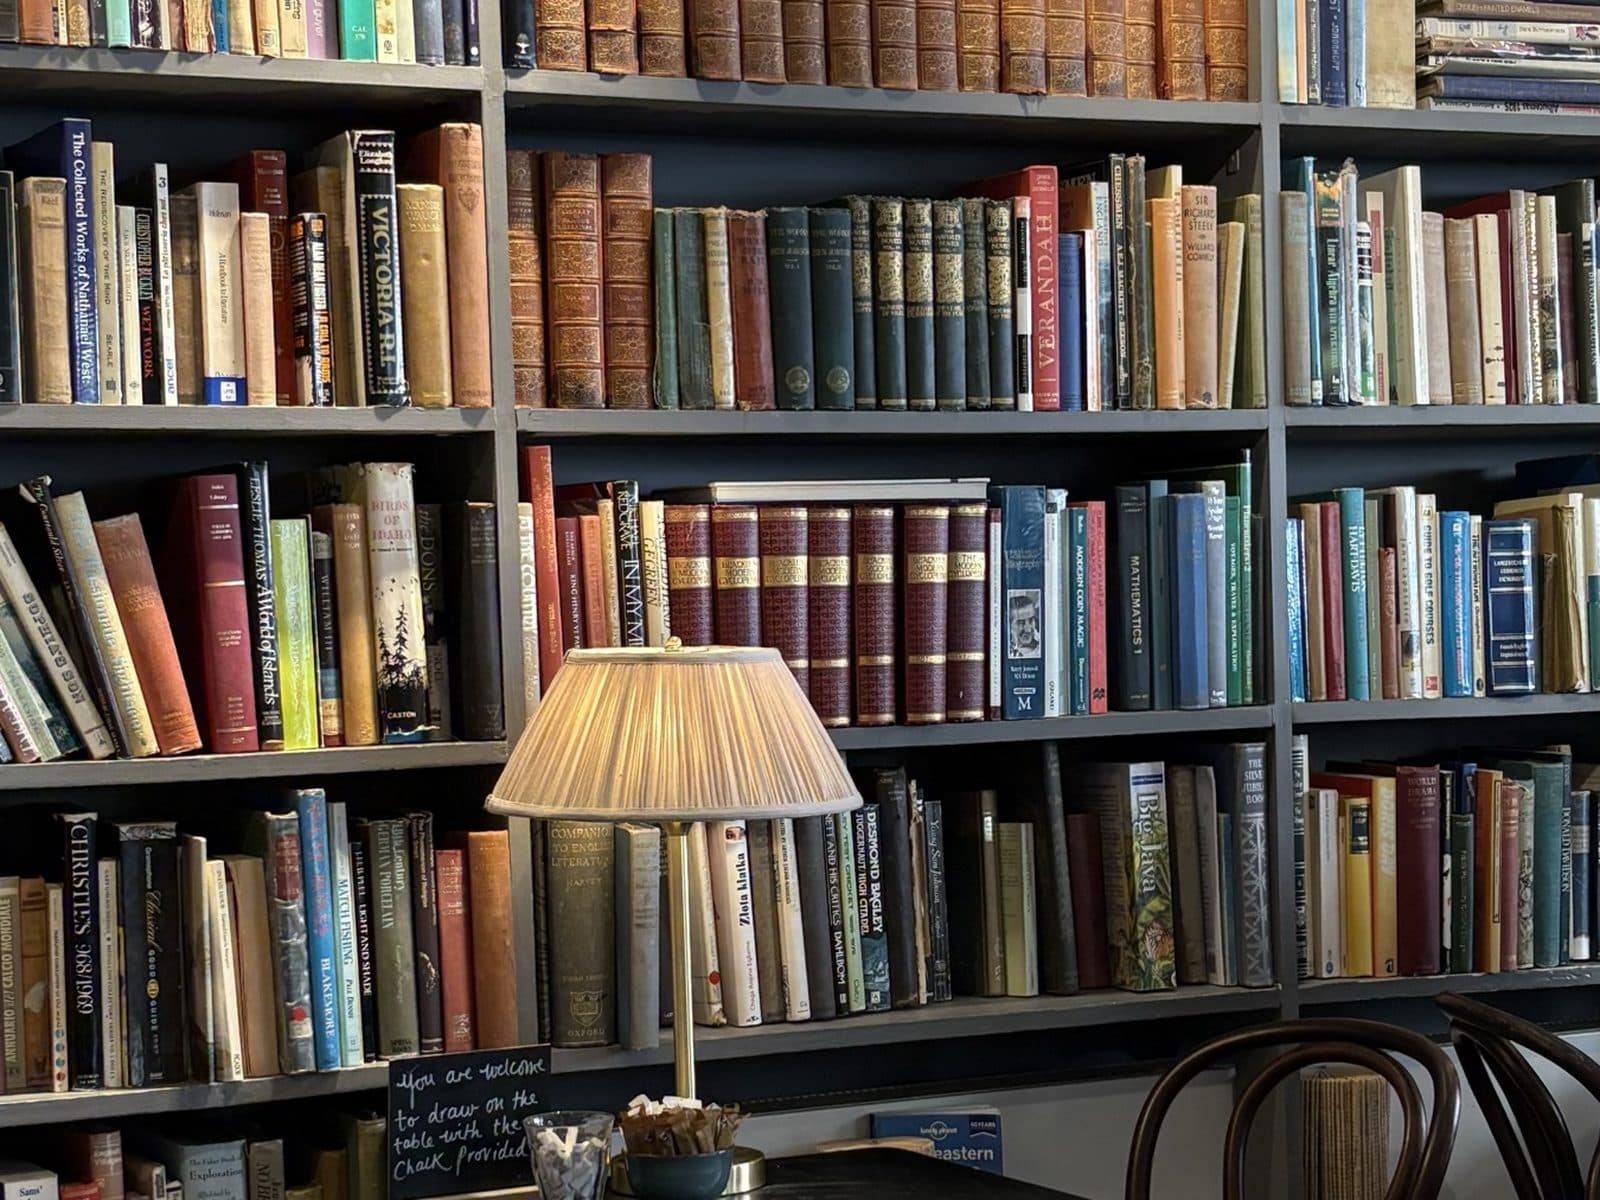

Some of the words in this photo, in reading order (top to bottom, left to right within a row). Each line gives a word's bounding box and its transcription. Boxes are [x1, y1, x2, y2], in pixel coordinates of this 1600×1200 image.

[72, 132, 85, 152] The
[73, 155, 89, 218] Collected
[99, 169, 107, 186] THE
[1113, 165, 1124, 229] CHESSMEN
[1184, 209, 1215, 218] RICHARD
[1195, 196, 1208, 205] SIR
[99, 189, 109, 247] REDISCOVERY
[1096, 196, 1104, 247] ENGLAND
[1189, 222, 1214, 231] STEELE
[76, 221, 88, 263] Works
[136, 213, 152, 267] CHRISTOPHER
[311, 242, 324, 260] ALAN
[78, 265, 90, 278] of
[138, 268, 153, 301] BUCKLEY
[312, 261, 326, 281] DEAN
[372, 207, 393, 327] VICTORIA
[313, 282, 327, 309] FOSTER
[1036, 213, 1055, 369] VERANDAH
[1326, 271, 1339, 305] Algebra
[78, 280, 93, 345] Nathanael
[142, 305, 152, 333] WET
[81, 349, 94, 384] West:
[143, 337, 154, 378] WORK
[248, 478, 263, 521] LESLIE
[371, 501, 409, 511] BIRDS
[372, 530, 412, 540] IDAHO
[384, 515, 401, 525] OF
[617, 491, 631, 551] REDGRAVE
[1424, 525, 1432, 551] GUIDE
[254, 525, 267, 581] THOMAS
[420, 535, 437, 591] DONS
[624, 559, 639, 579] IN
[1349, 526, 1361, 592] HART-DAVIS
[1424, 557, 1433, 569] TO
[257, 584, 272, 597] A
[570, 574, 578, 595] KING
[645, 559, 658, 606] GREEN
[1131, 556, 1142, 644] MATHEMATICS
[1425, 573, 1433, 597] GOLF
[258, 597, 273, 638] World
[320, 574, 332, 631] WILLIAM
[571, 597, 579, 623] HENRY
[626, 585, 643, 618] MY
[1425, 601, 1434, 645] COURSES
[22, 592, 67, 667] SOPHIA'S
[60, 670, 86, 705] SON
[259, 639, 277, 653] of
[262, 655, 279, 704] Islands
[1018, 697, 1032, 711] M
[1248, 759, 1262, 769] THE
[1407, 777, 1437, 786] WORLD
[825, 813, 836, 839] NETT
[1134, 793, 1160, 835] Big
[1561, 807, 1571, 845] DONALD
[378, 822, 392, 867] GERMAN
[551, 827, 609, 839] COMPANIO
[552, 843, 568, 853] TO
[843, 834, 851, 860] TEST
[867, 811, 880, 880] DESMOND
[551, 856, 609, 868] LITERATU
[827, 842, 837, 865] AND
[1140, 842, 1162, 893] Java
[70, 824, 92, 935] CHRISTIE'S
[829, 868, 838, 884] HIS
[845, 864, 854, 909] CRICKET
[338, 878, 351, 918] MATCH
[380, 871, 394, 929] PORCELAIN
[830, 886, 841, 926] CRITICS
[869, 881, 882, 933] BAGLEY
[0, 898, 12, 950] MONDIALE
[358, 904, 369, 934] LIGHT
[859, 898, 870, 935] CITADEL
[340, 921, 354, 965] FISHING
[360, 935, 371, 959] AND
[834, 931, 846, 984] DAHLBOM
[2, 954, 14, 988] CALCIO
[74, 944, 94, 1014] 968/1969
[148, 950, 156, 978] GOOD
[362, 961, 373, 996] SHADE
[320, 958, 336, 1038] BLAKEMORE
[4, 1009, 16, 1062] ANNUARIO
[568, 1029, 605, 1037] OXFORD
[446, 1067, 473, 1083] are
[480, 1058, 545, 1080] welcome
[394, 1109, 420, 1131] to
[428, 1102, 479, 1124] draw
[487, 1096, 504, 1113] on
[512, 1089, 539, 1110] the
[393, 1131, 434, 1155] table
[439, 1120, 483, 1143] with
[494, 1115, 522, 1135] the
